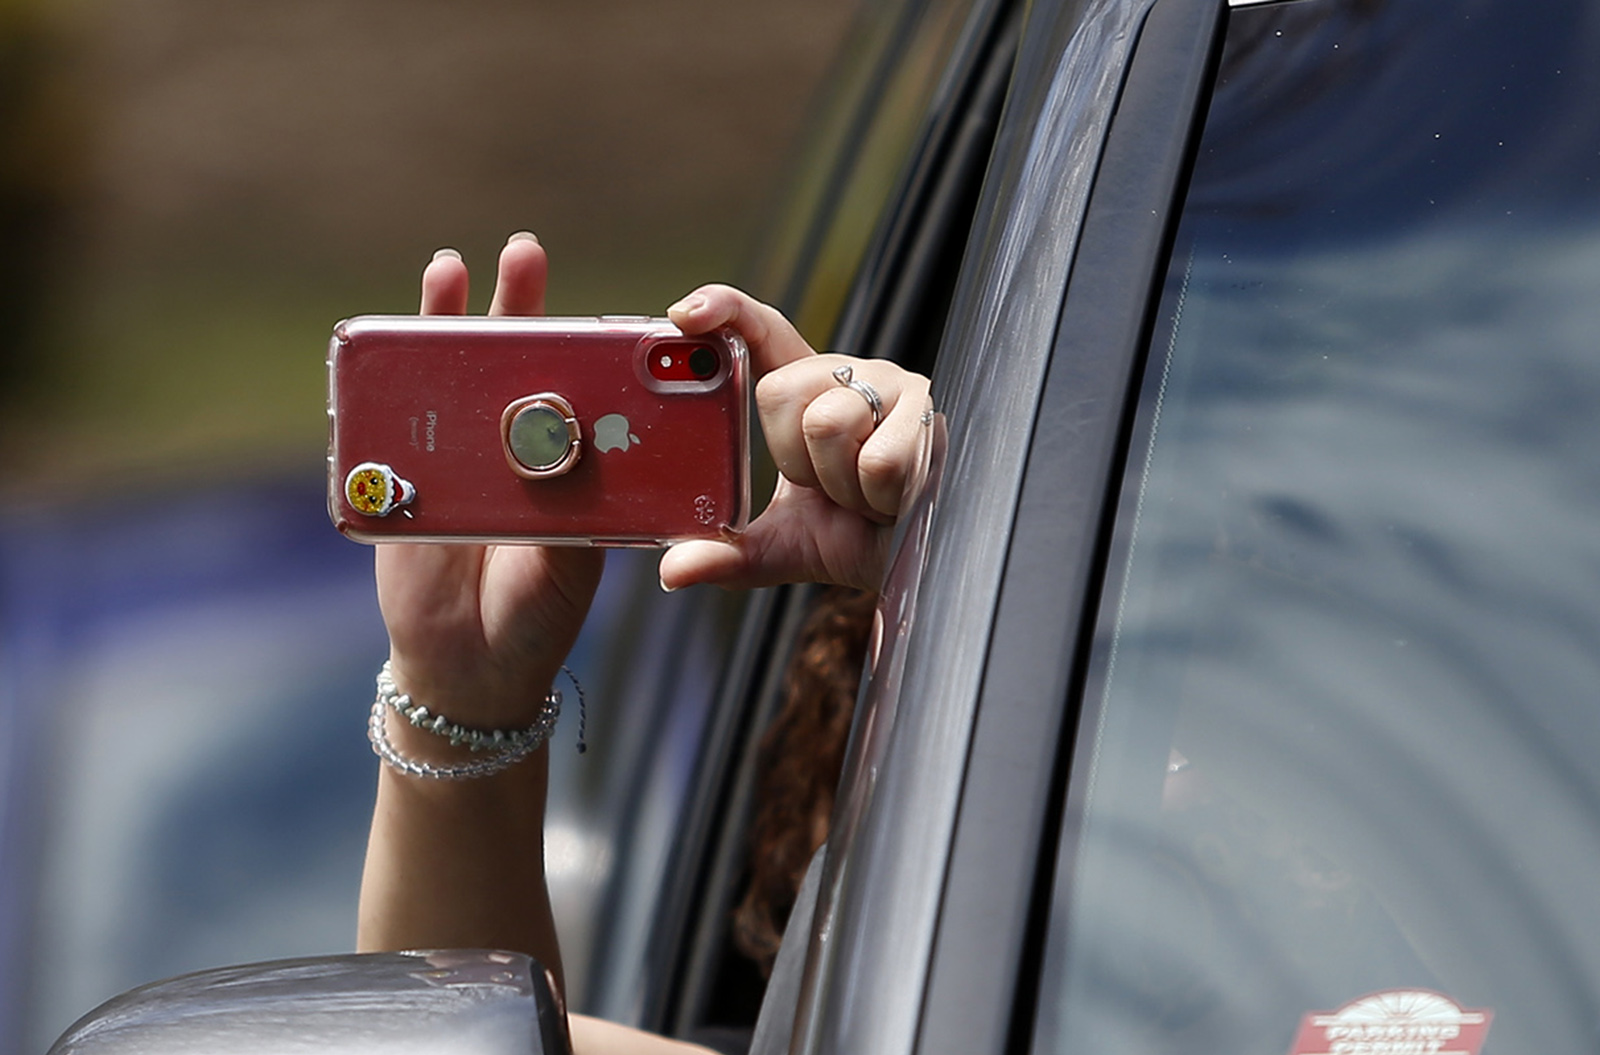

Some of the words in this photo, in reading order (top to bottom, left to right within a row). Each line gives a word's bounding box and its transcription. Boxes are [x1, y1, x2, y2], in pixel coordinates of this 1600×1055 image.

[426, 410, 437, 452] iPhone
[1327, 1023, 1460, 1041] PARKING
[1330, 1039, 1443, 1055] PERMIT
